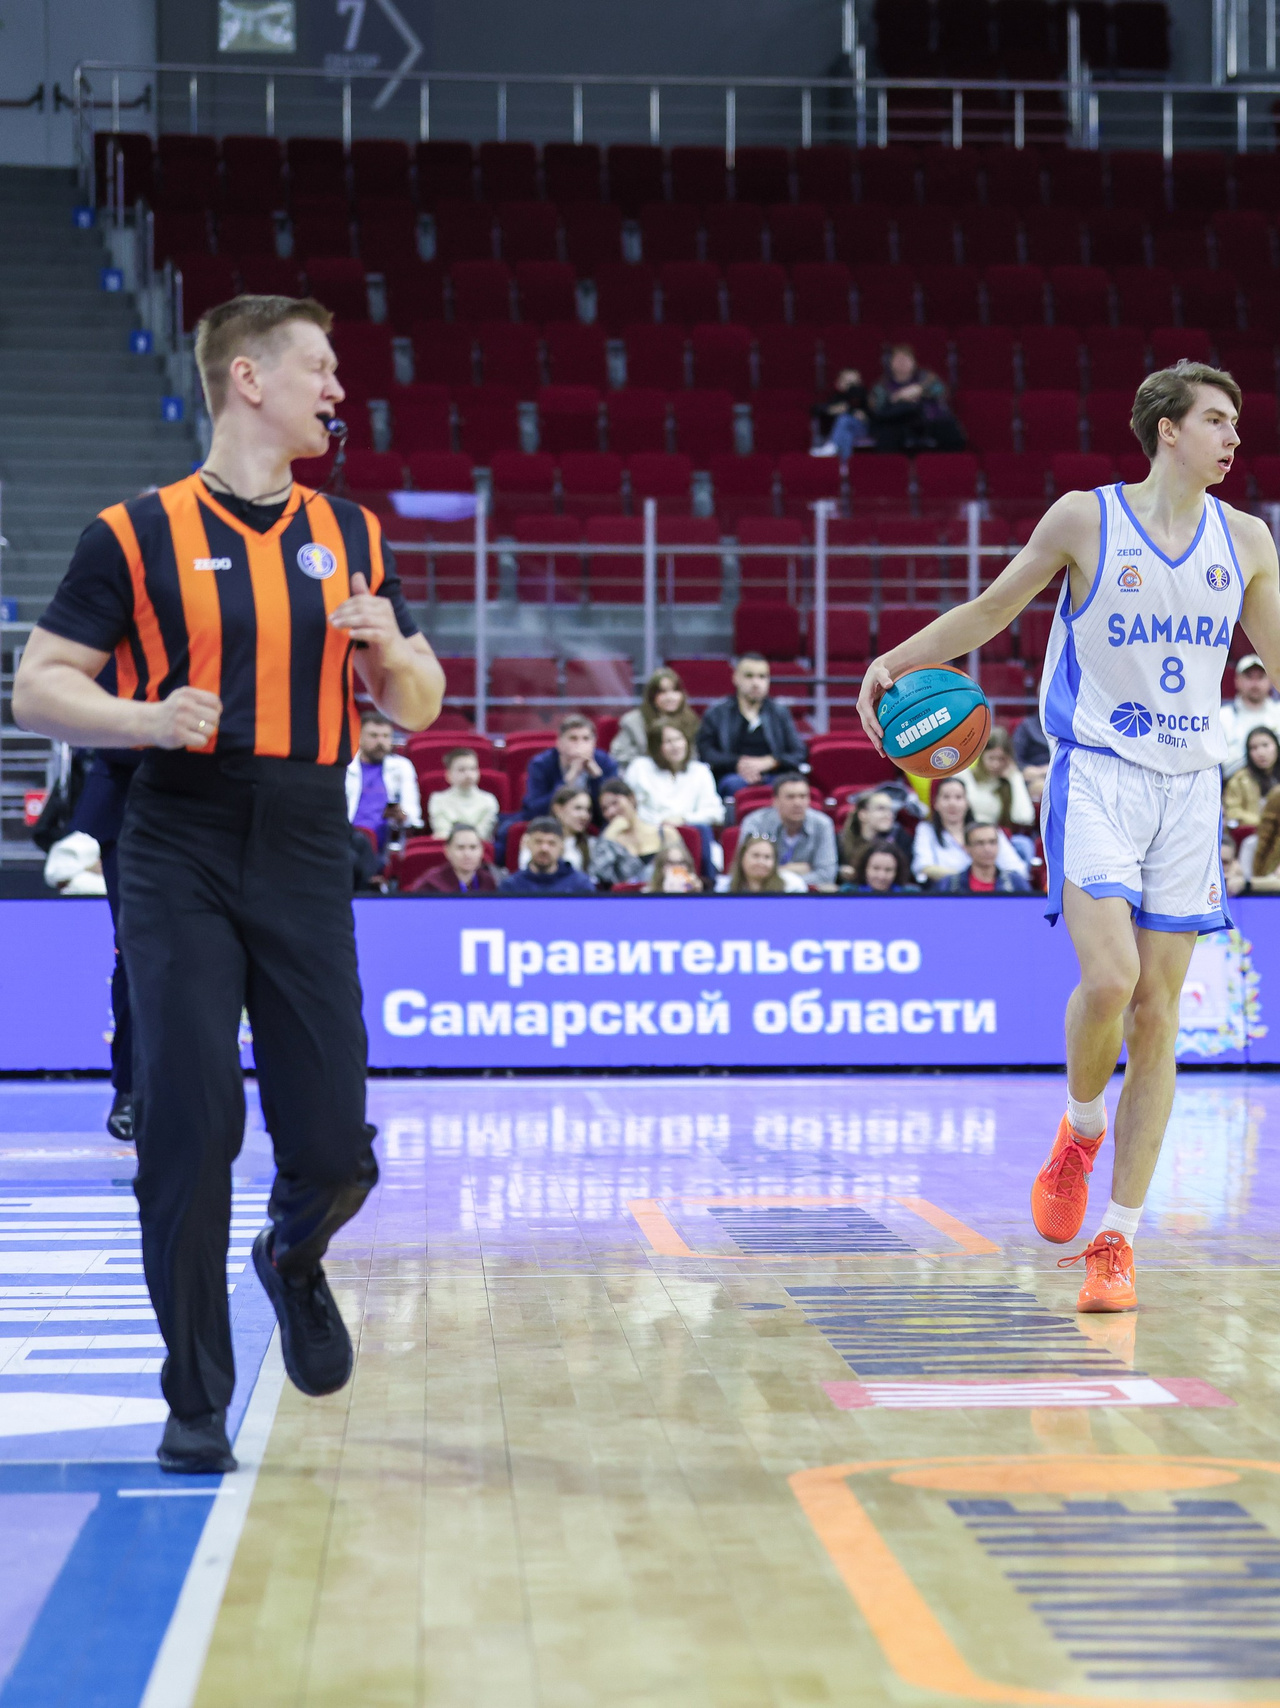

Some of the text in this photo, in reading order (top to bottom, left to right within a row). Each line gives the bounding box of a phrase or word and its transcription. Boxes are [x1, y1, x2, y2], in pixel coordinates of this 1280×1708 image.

[336, 0, 366, 51] 7
[1117, 548, 1142, 557] ZEDO
[1108, 613, 1230, 650] SAMARA
[1159, 656, 1186, 694] 8
[895, 707, 951, 749] SIBUR
[1157, 733, 1188, 748] ВОЛГА
[1081, 873, 1107, 884] ZEDO
[460, 928, 922, 988] Правительство
[383, 987, 997, 1049] Самарской области
